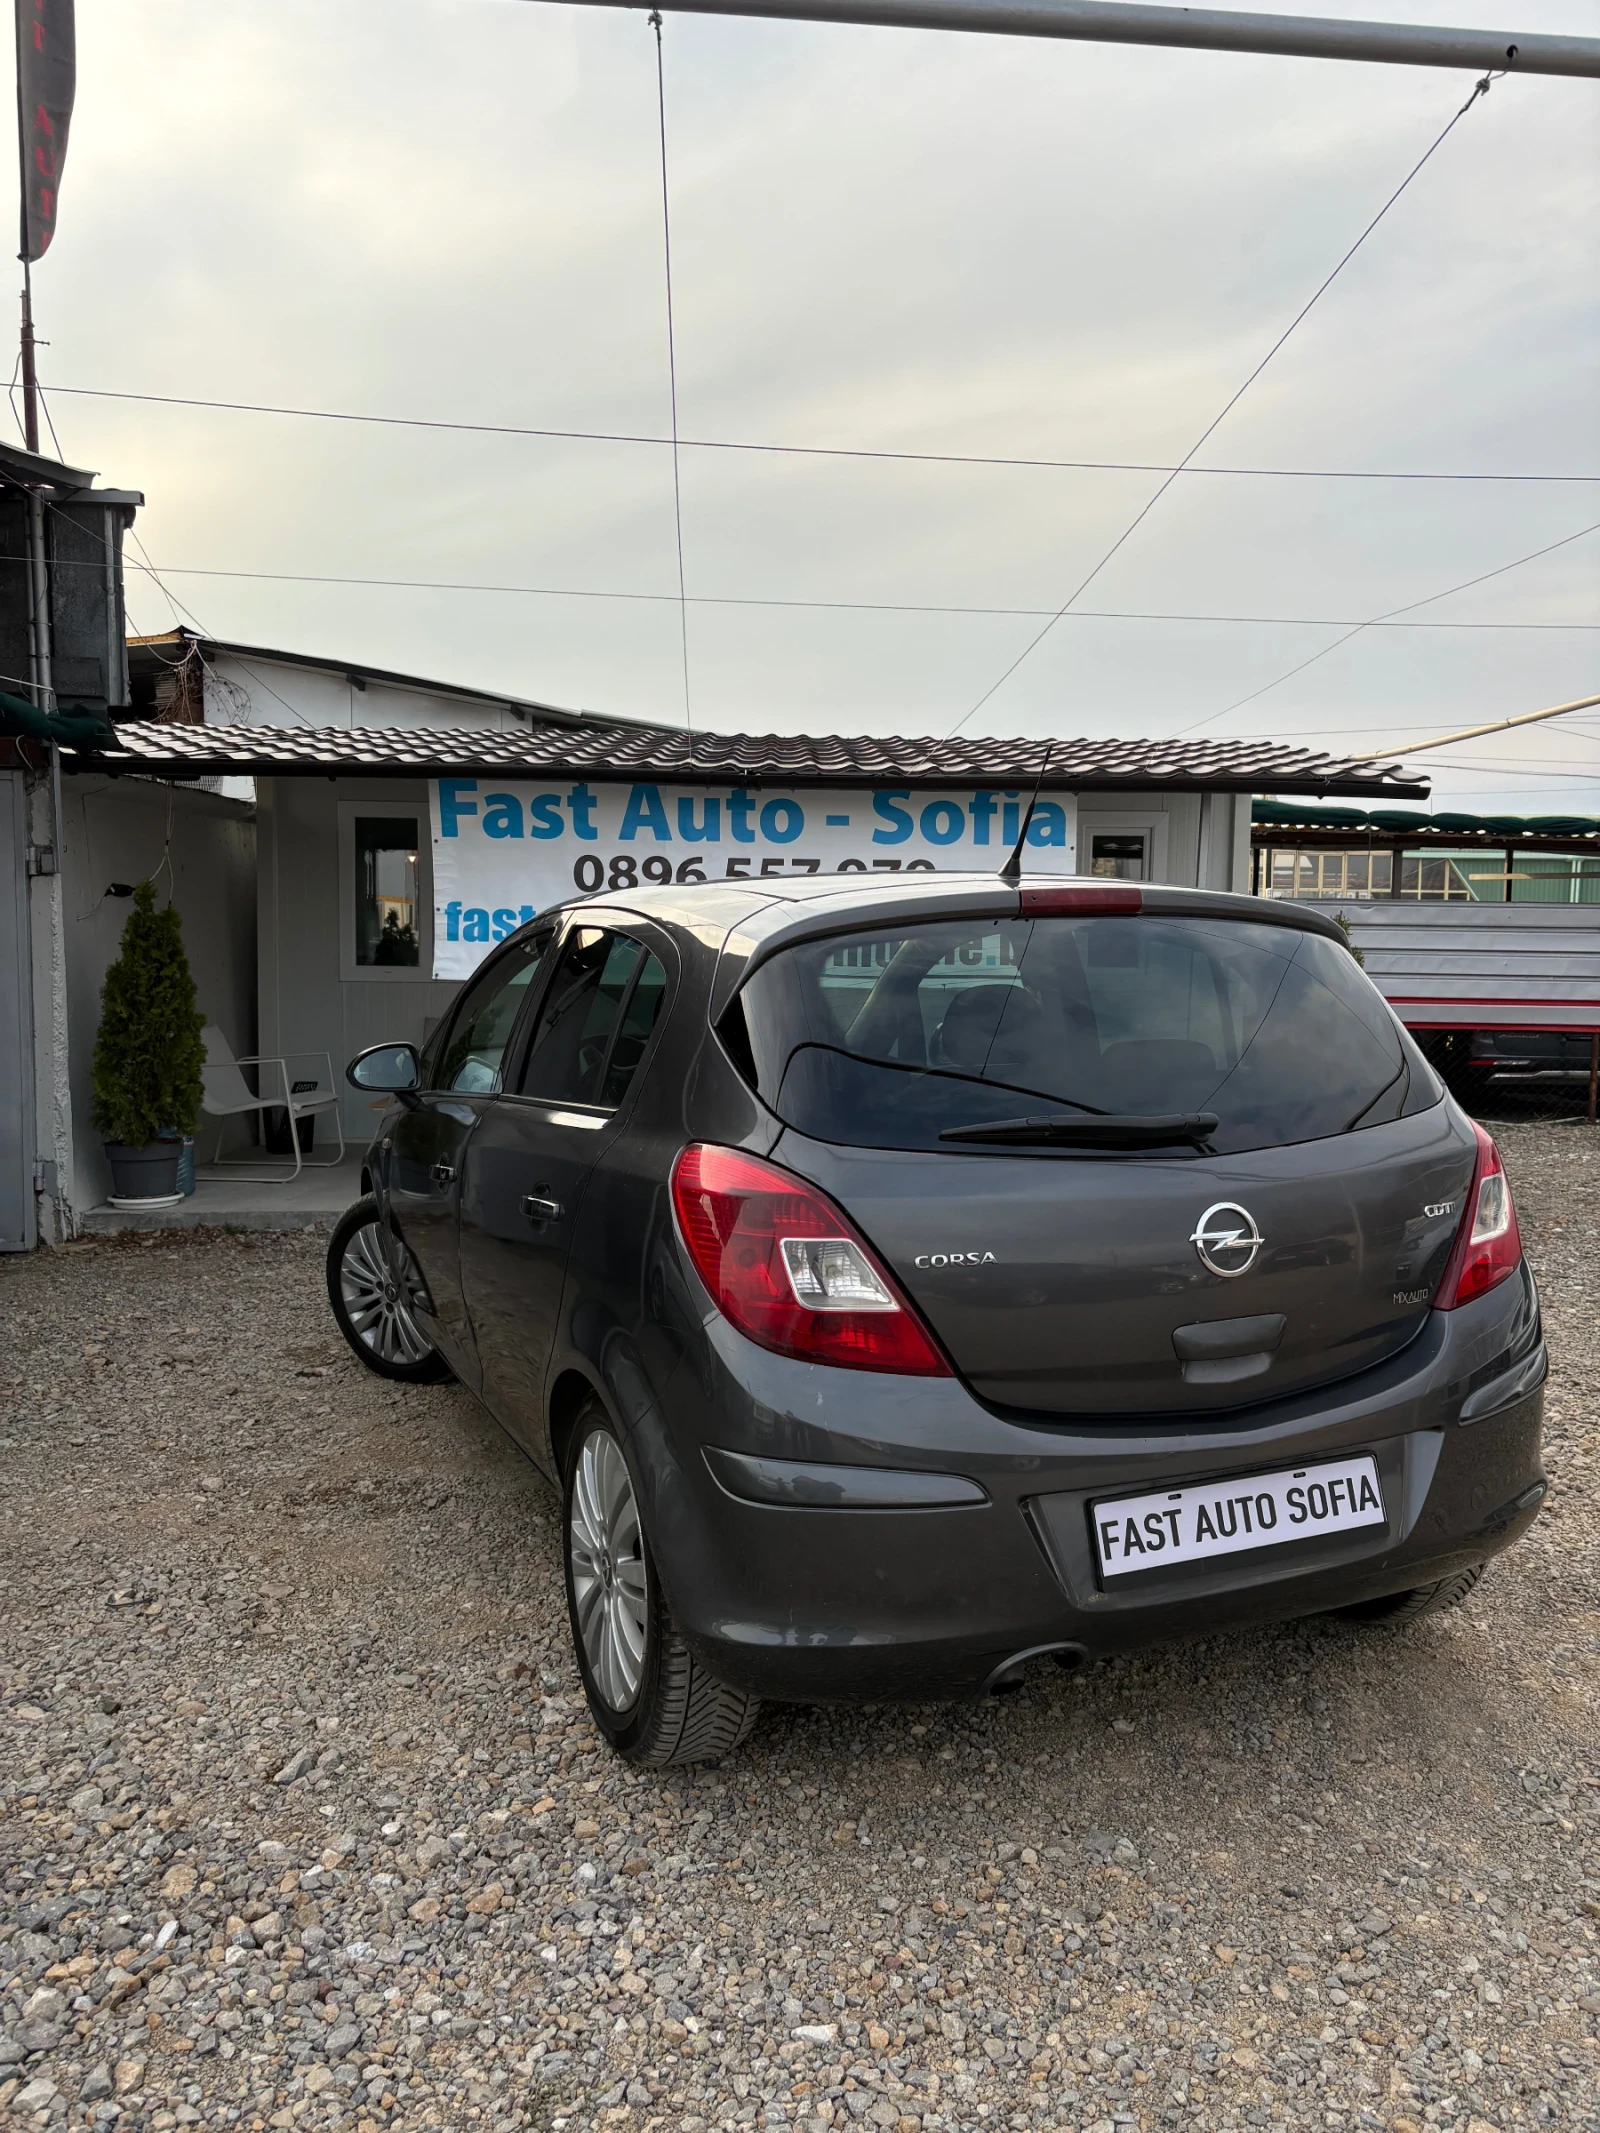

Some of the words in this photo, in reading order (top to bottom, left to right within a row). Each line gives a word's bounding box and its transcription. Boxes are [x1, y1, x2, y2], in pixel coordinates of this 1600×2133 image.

[438, 779, 598, 840] Fast
[618, 784, 804, 843] Auto
[825, 814, 850, 827] -
[871, 790, 1067, 847] Sofia
[573, 854, 707, 893] 0896
[1424, 1201, 1455, 1217] CDTI
[914, 1251, 999, 1269] CORSA
[1100, 1508, 1182, 1561] FAST
[1195, 1492, 1278, 1543] AUTO
[1286, 1474, 1380, 1524] SOFIA
